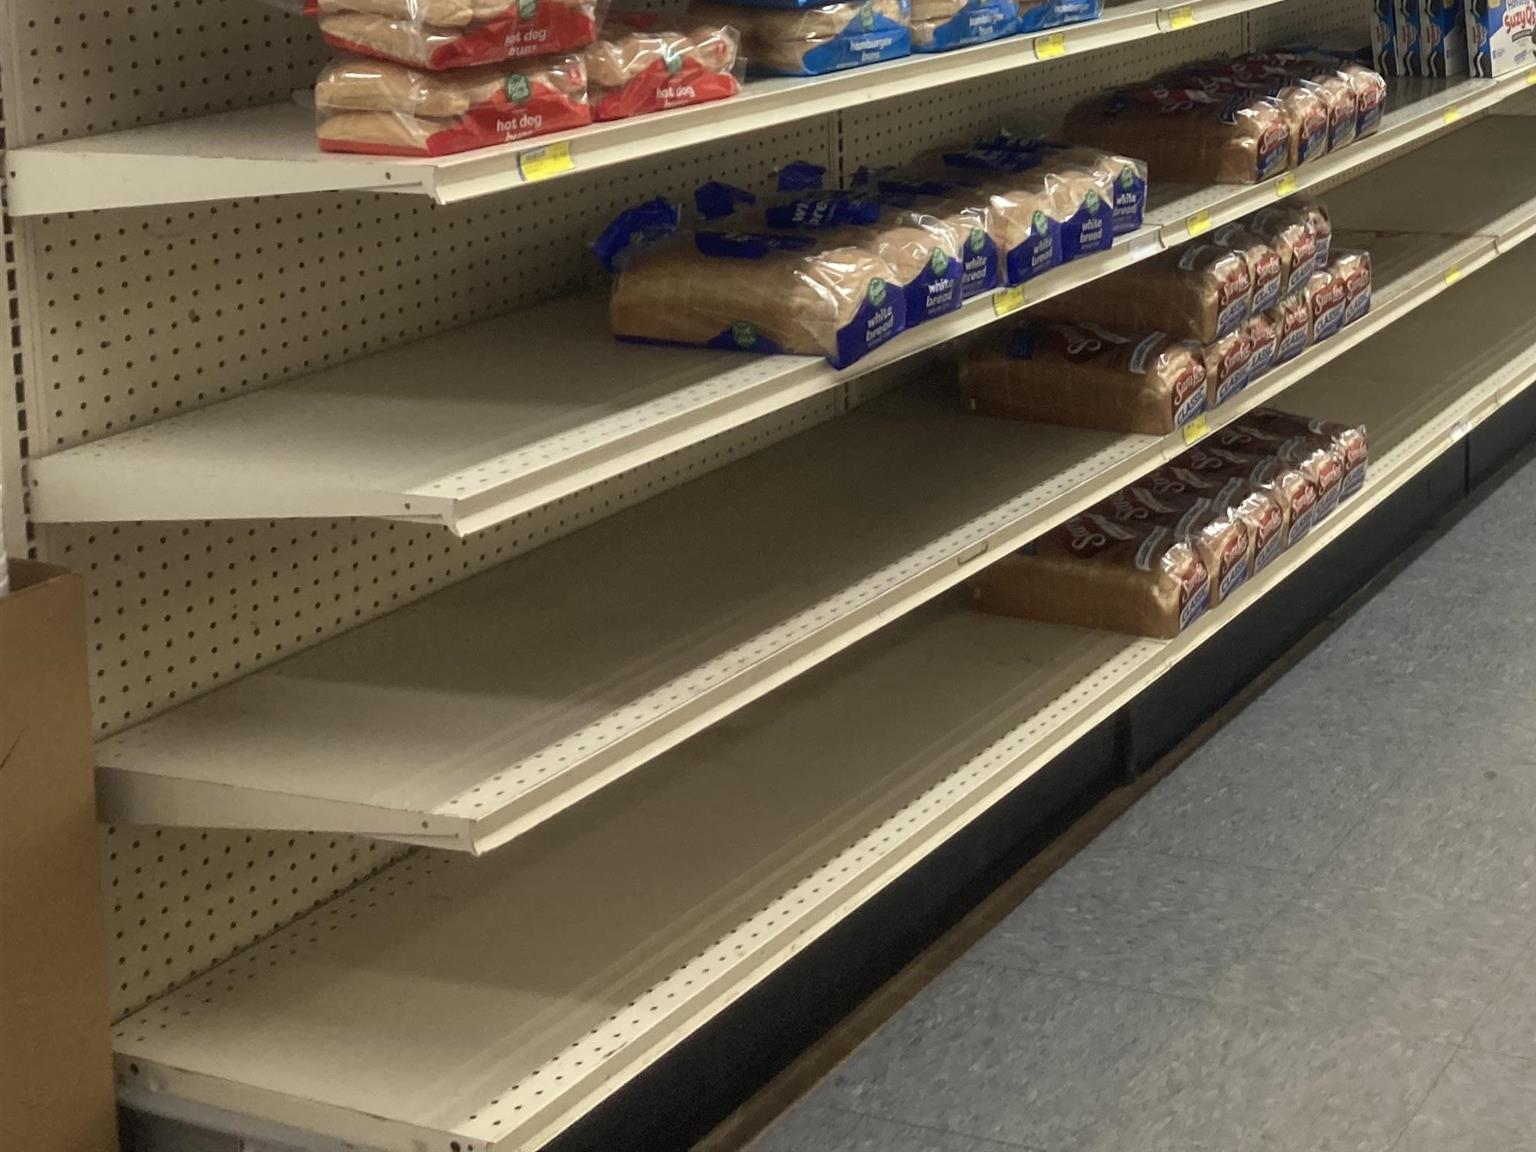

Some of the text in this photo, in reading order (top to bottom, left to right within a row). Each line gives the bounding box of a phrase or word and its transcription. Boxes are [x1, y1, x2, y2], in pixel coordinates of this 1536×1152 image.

[656, 87, 674, 99] hot
[496, 114, 542, 132] hot dog
[1116, 193, 1136, 205] white
[1081, 218, 1103, 231] white
[965, 256, 987, 269] white
[928, 278, 954, 294] white
[926, 291, 953, 308] bread
[867, 306, 893, 329] white
[865, 314, 894, 342] bread
